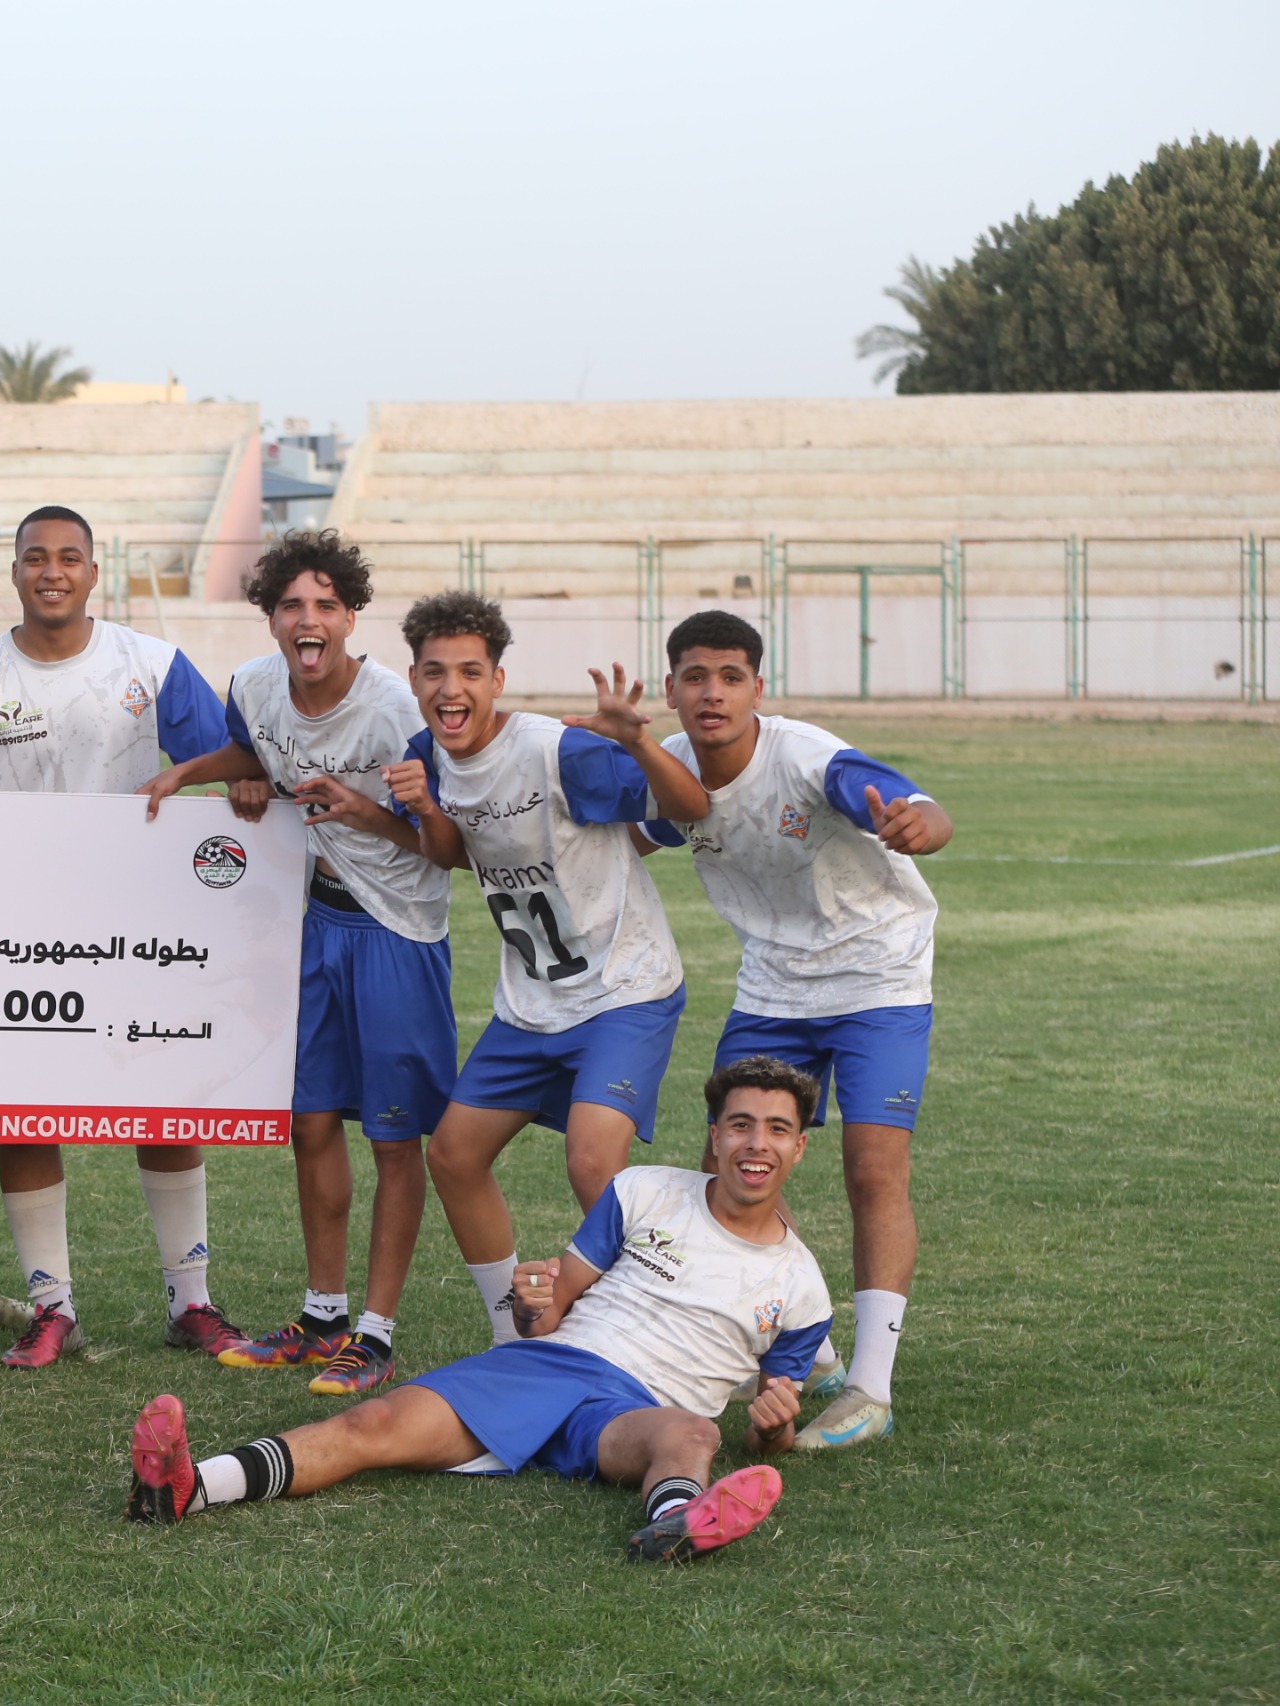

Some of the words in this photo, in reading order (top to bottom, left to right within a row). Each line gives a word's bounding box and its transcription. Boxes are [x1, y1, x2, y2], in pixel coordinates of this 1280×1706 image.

[15, 714, 44, 726] CARE
[338, 758, 381, 774] محمد
[466, 801, 503, 831] ناجي
[503, 792, 544, 818] محمد
[132, 937, 209, 969] بطوله
[126, 1020, 212, 1043] المبلغ
[162, 1118, 284, 1141] EDUCATE.
[179, 1254, 209, 1264] adida
[654, 1246, 685, 1268] CARE
[28, 1278, 59, 1291] adidas
[168, 1285, 176, 1303] 9
